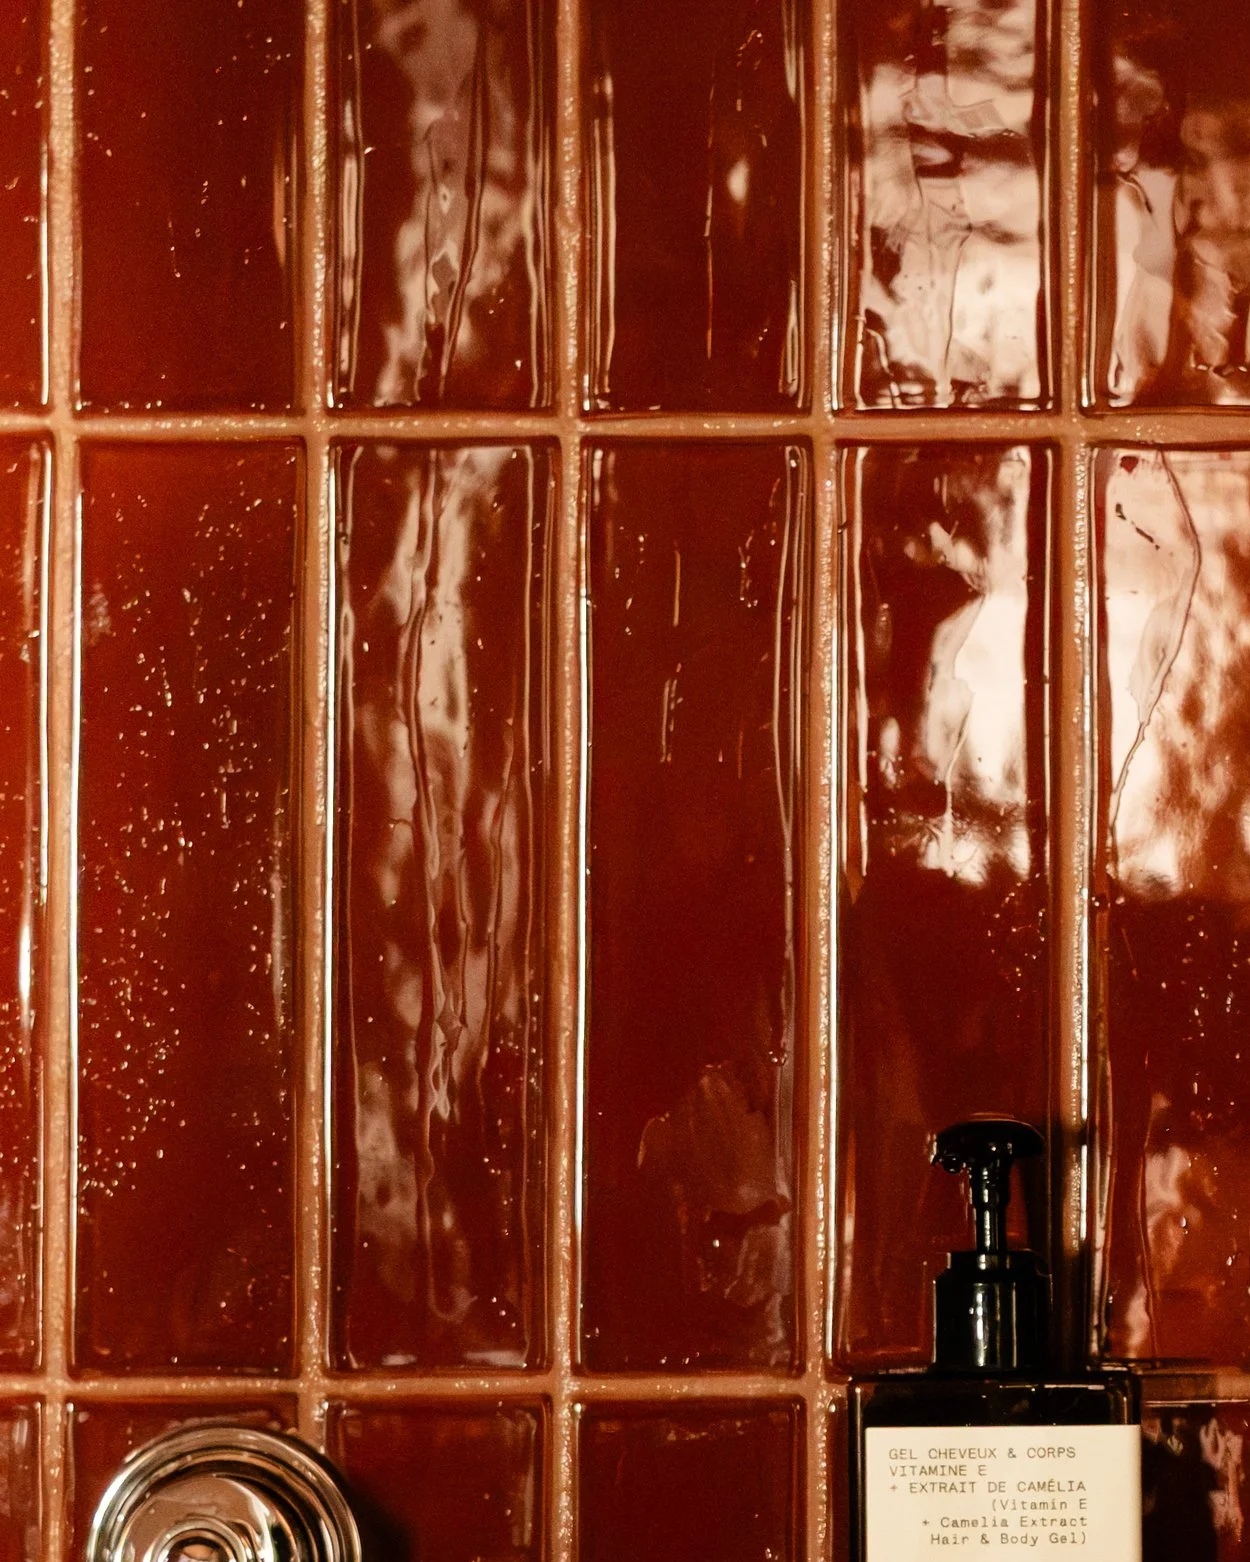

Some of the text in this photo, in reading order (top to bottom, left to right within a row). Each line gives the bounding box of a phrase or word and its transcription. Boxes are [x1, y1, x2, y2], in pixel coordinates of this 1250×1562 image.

[888, 1446, 1076, 1460] GEL CHEVEUX & CORPS
[889, 1464, 987, 1477] VITAMINE E
[909, 1481, 977, 1494] EXTRAIT
[987, 1481, 1007, 1494] DE
[1017, 1478, 1087, 1493] CAMÉLIA
[991, 1497, 1087, 1512] (Vitamin E
[940, 1516, 1009, 1529] Camelia
[1019, 1515, 1088, 1528] Extract
[930, 1531, 1086, 1548] Hair & Body Gel)
